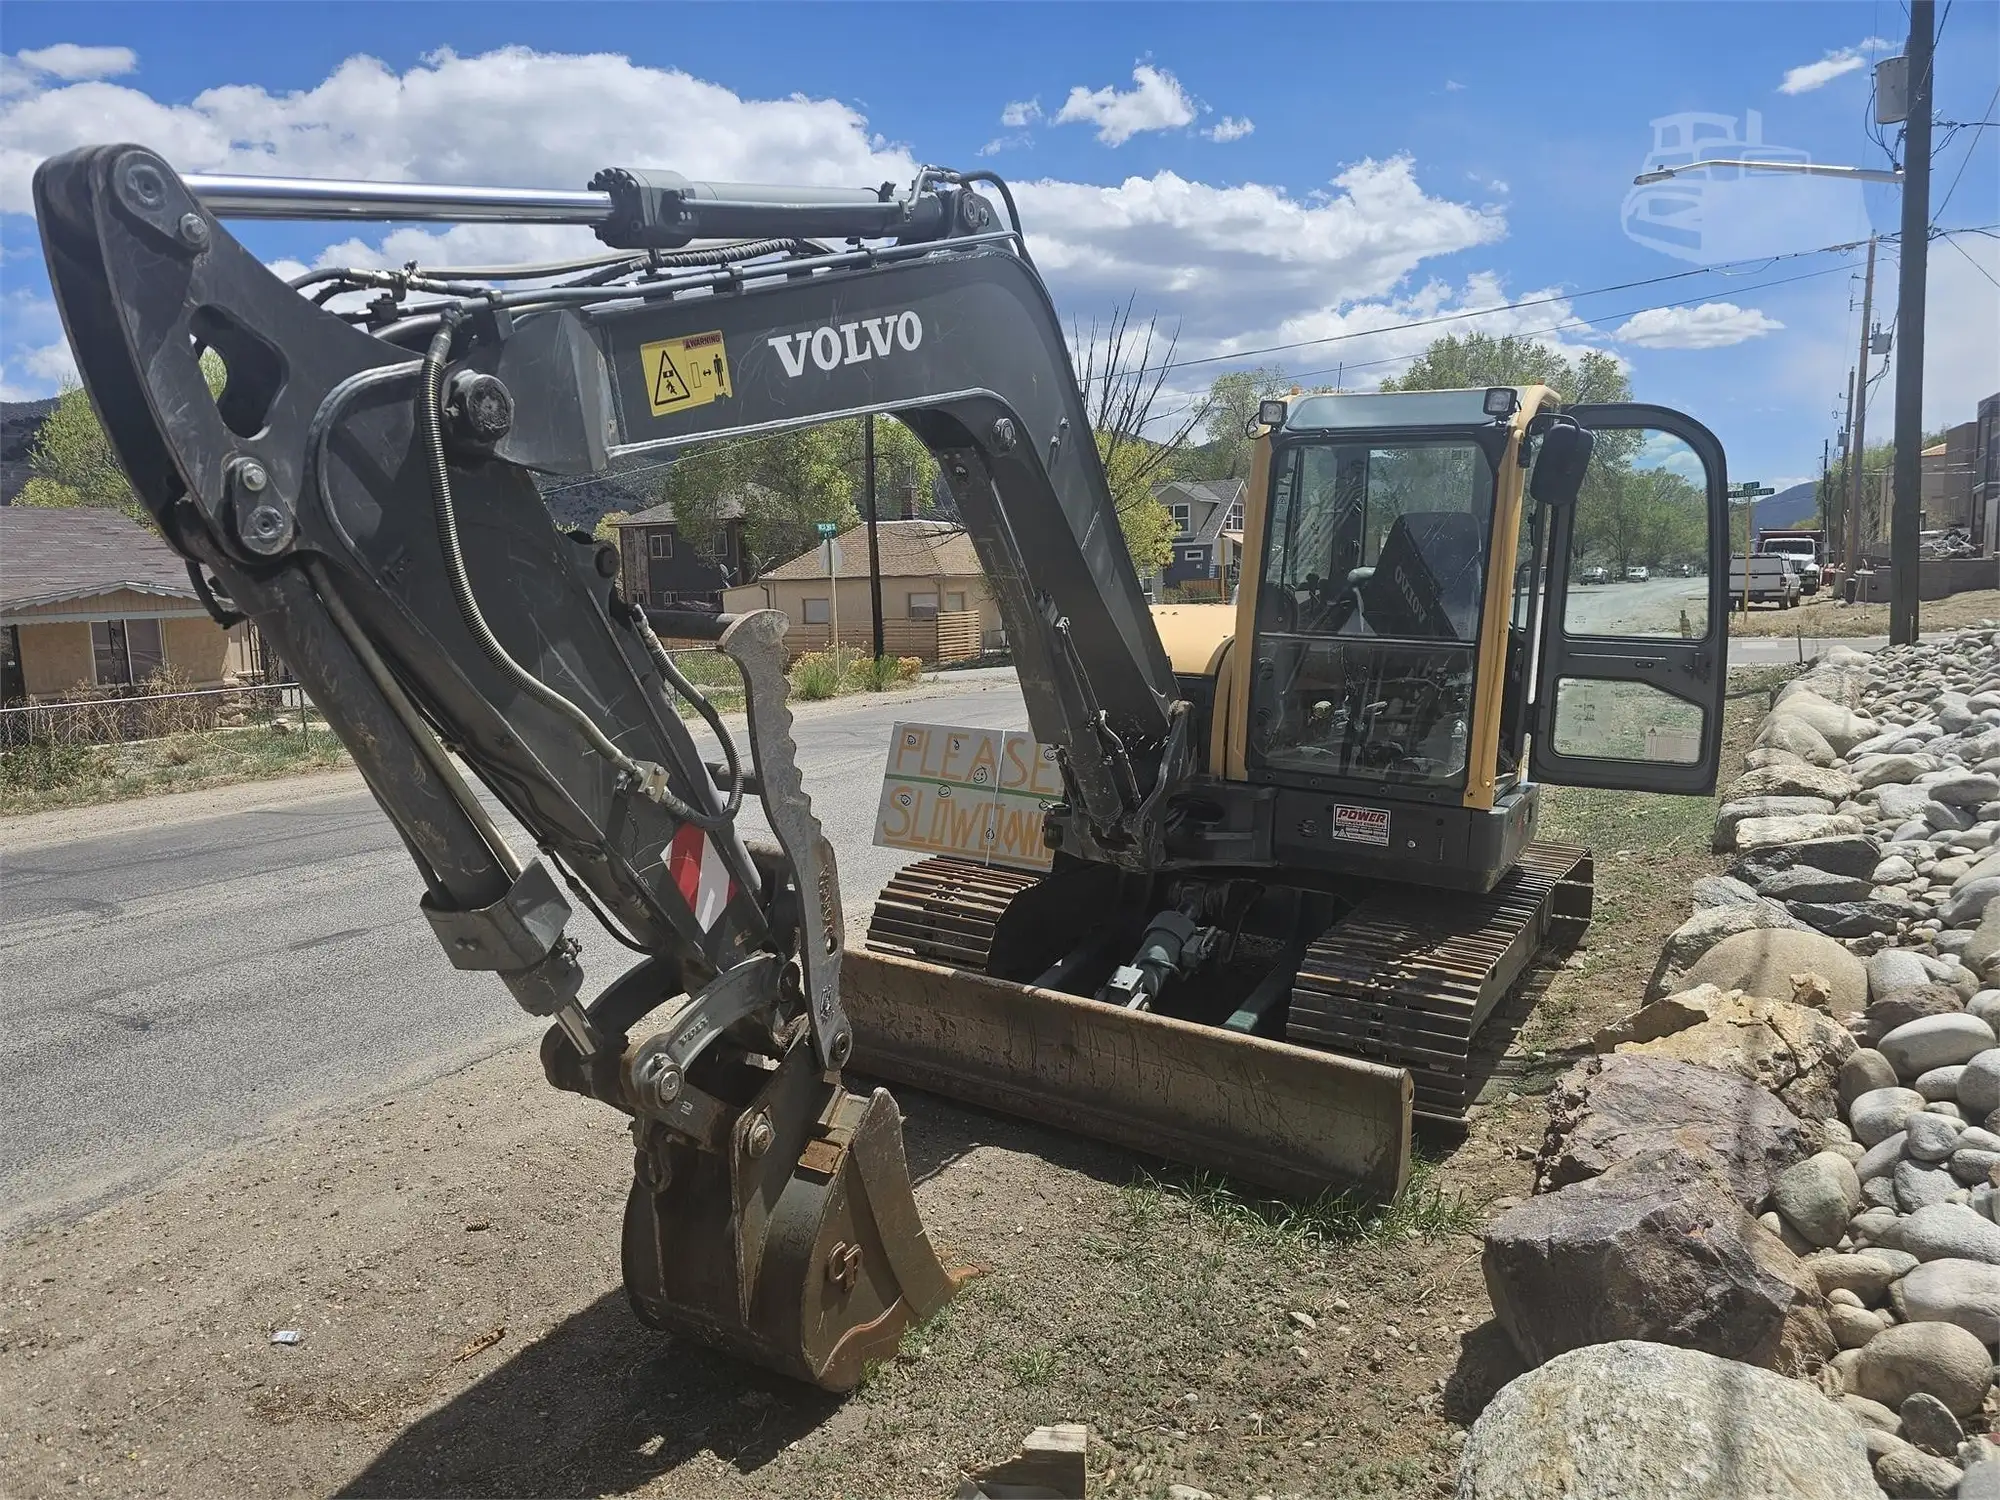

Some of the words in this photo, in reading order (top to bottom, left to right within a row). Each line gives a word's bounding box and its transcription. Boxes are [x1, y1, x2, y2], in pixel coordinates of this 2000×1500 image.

[690, 334, 721, 347] WARNING
[768, 311, 922, 378] VOLVO
[896, 727, 1055, 793] PLEASE
[1338, 809, 1386, 823] POWER
